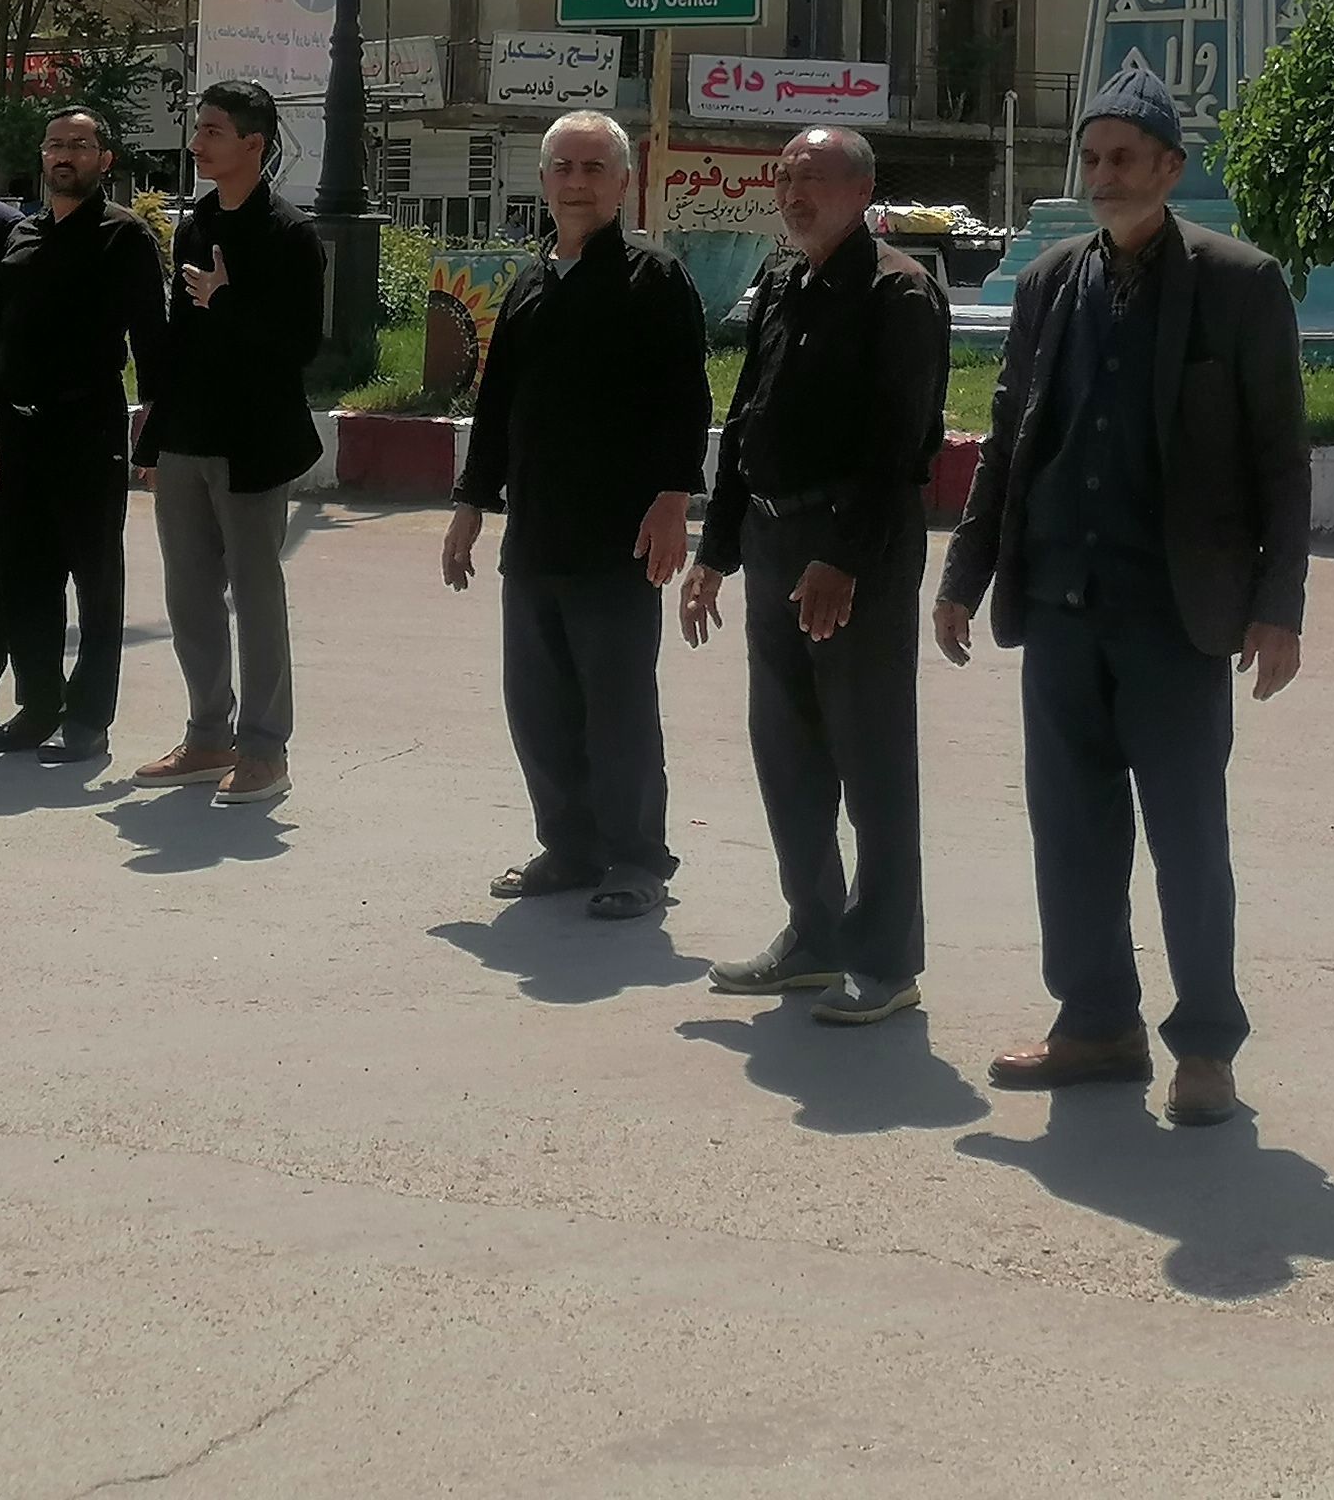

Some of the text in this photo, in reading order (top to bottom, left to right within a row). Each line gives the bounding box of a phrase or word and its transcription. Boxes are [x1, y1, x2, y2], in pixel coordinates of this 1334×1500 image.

[499, 40, 556, 64] خشکبار
[566, 41, 614, 70] برنج
[499, 76, 609, 103] حاجی قدیمی
[701, 60, 882, 103] حلیم داغ
[665, 156, 722, 202] فوم
